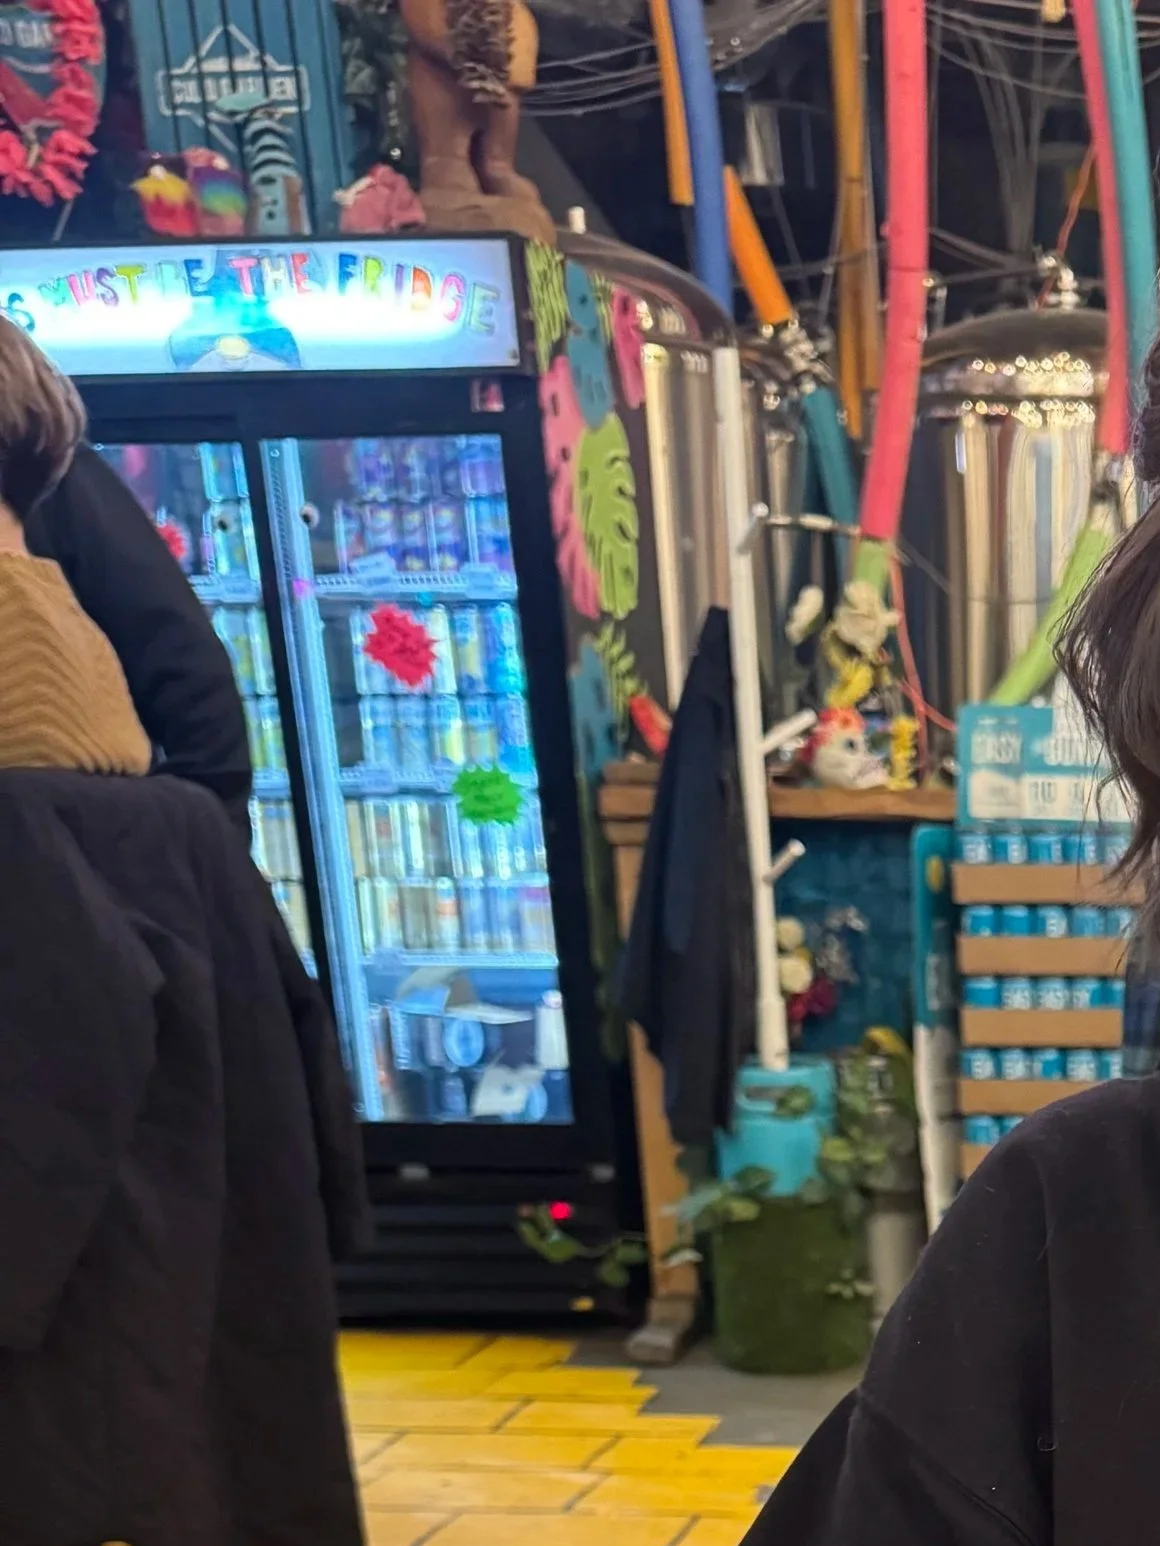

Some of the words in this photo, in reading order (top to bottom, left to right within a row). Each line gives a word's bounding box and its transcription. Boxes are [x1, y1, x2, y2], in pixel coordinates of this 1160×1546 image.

[38, 264, 146, 307] MUST
[228, 253, 313, 298] THE
[337, 253, 499, 337] FRIDGE
